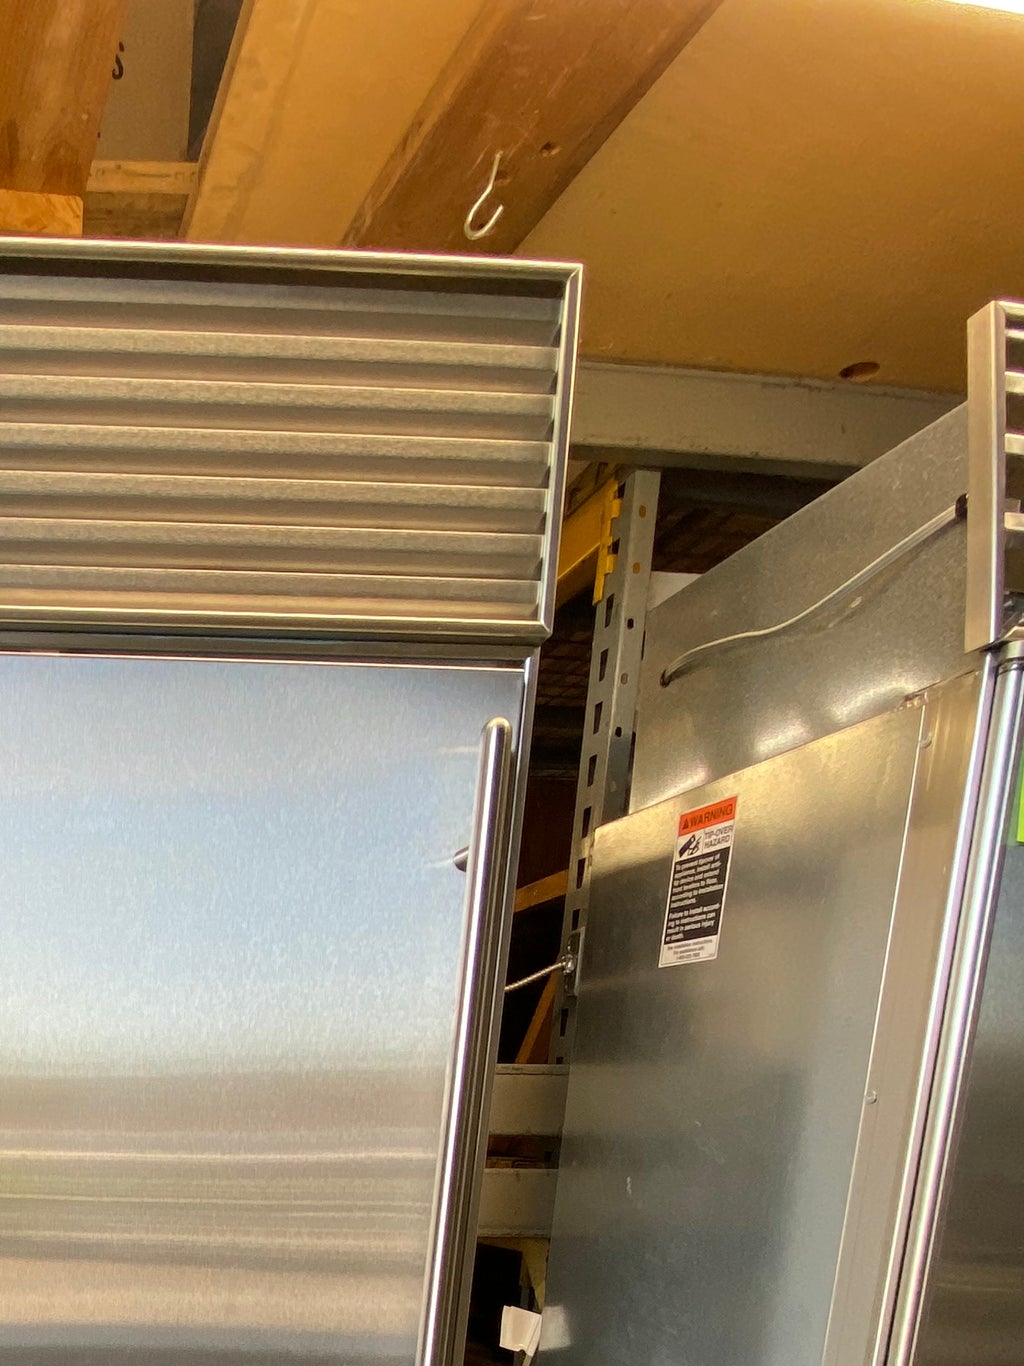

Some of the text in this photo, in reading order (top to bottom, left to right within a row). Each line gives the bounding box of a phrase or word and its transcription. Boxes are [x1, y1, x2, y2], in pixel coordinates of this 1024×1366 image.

[690, 804, 733, 828] WARNING
[705, 825, 733, 838] TIP-OVER
[705, 835, 731, 848] HAZARD
